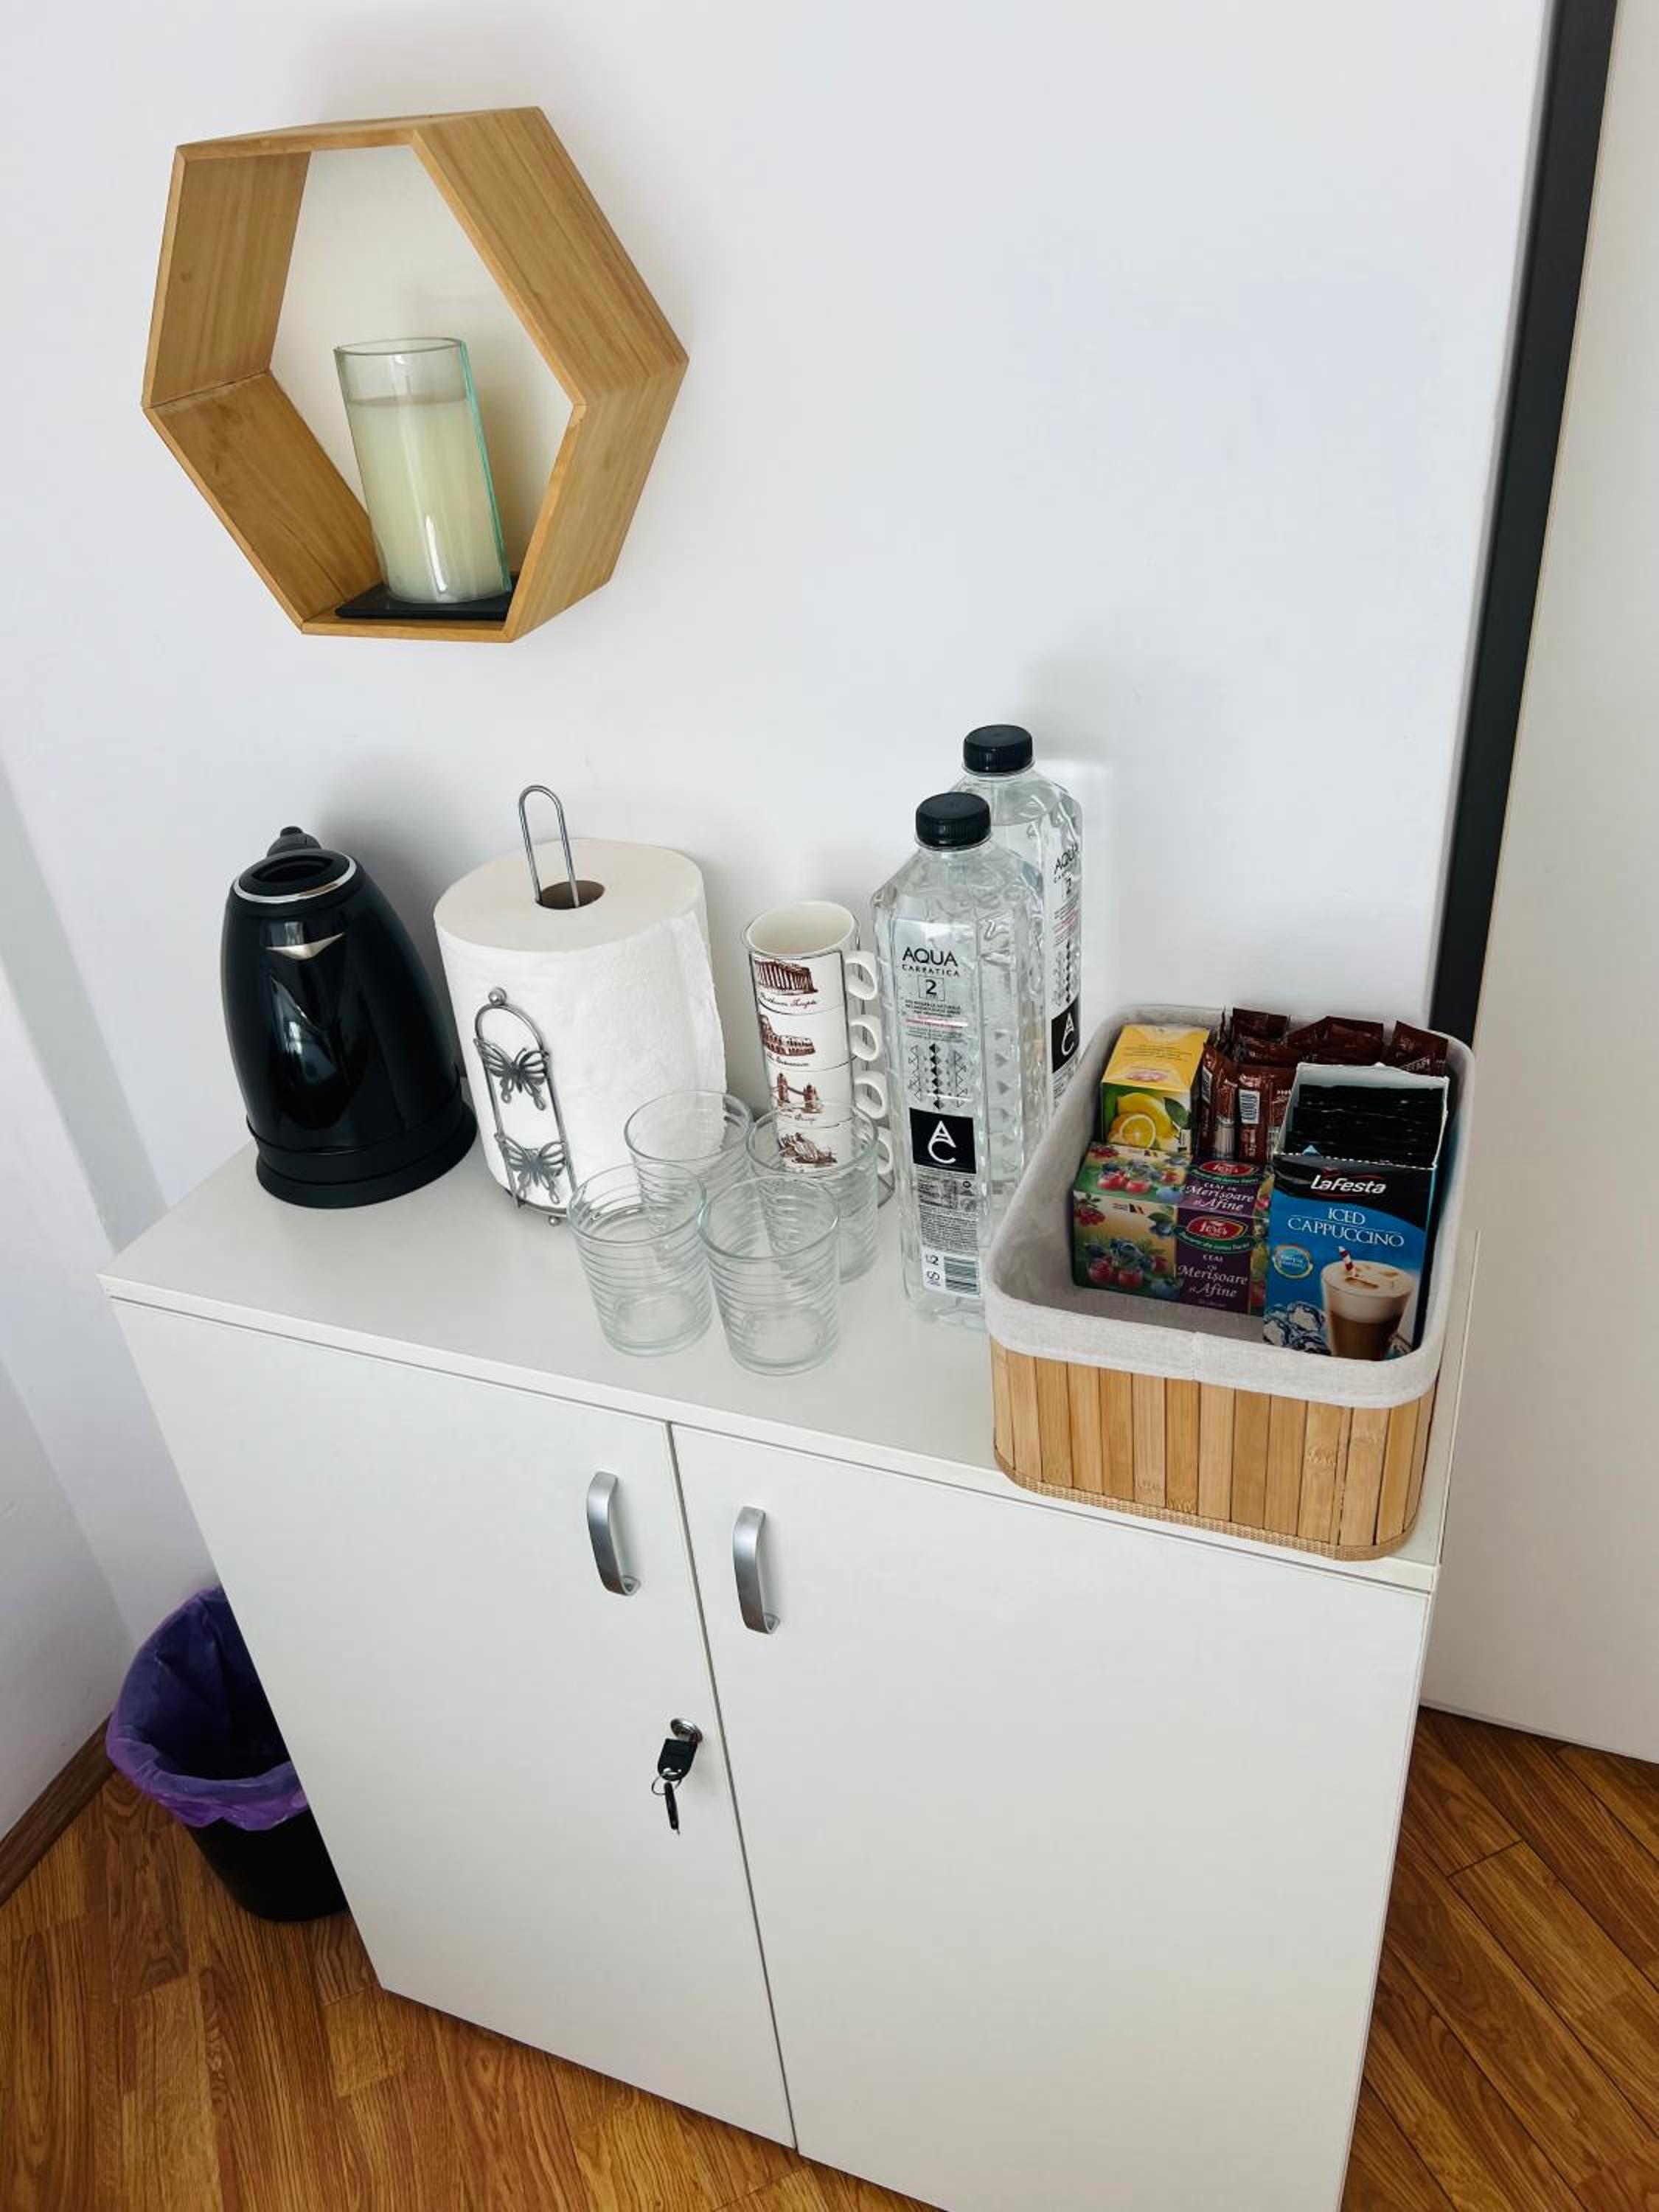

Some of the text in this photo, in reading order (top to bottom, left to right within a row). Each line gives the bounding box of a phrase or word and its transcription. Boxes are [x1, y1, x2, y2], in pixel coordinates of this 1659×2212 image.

[902, 947, 959, 967] AQUA
[902, 964, 961, 978] CARPATICA
[925, 979, 937, 995] 2
[1200, 1197, 1244, 1211] Afine
[1328, 1208, 1366, 1225] ICED
[1287, 1217, 1405, 1248] CAPPUCCINO
[1196, 1282, 1237, 1297] Afine
